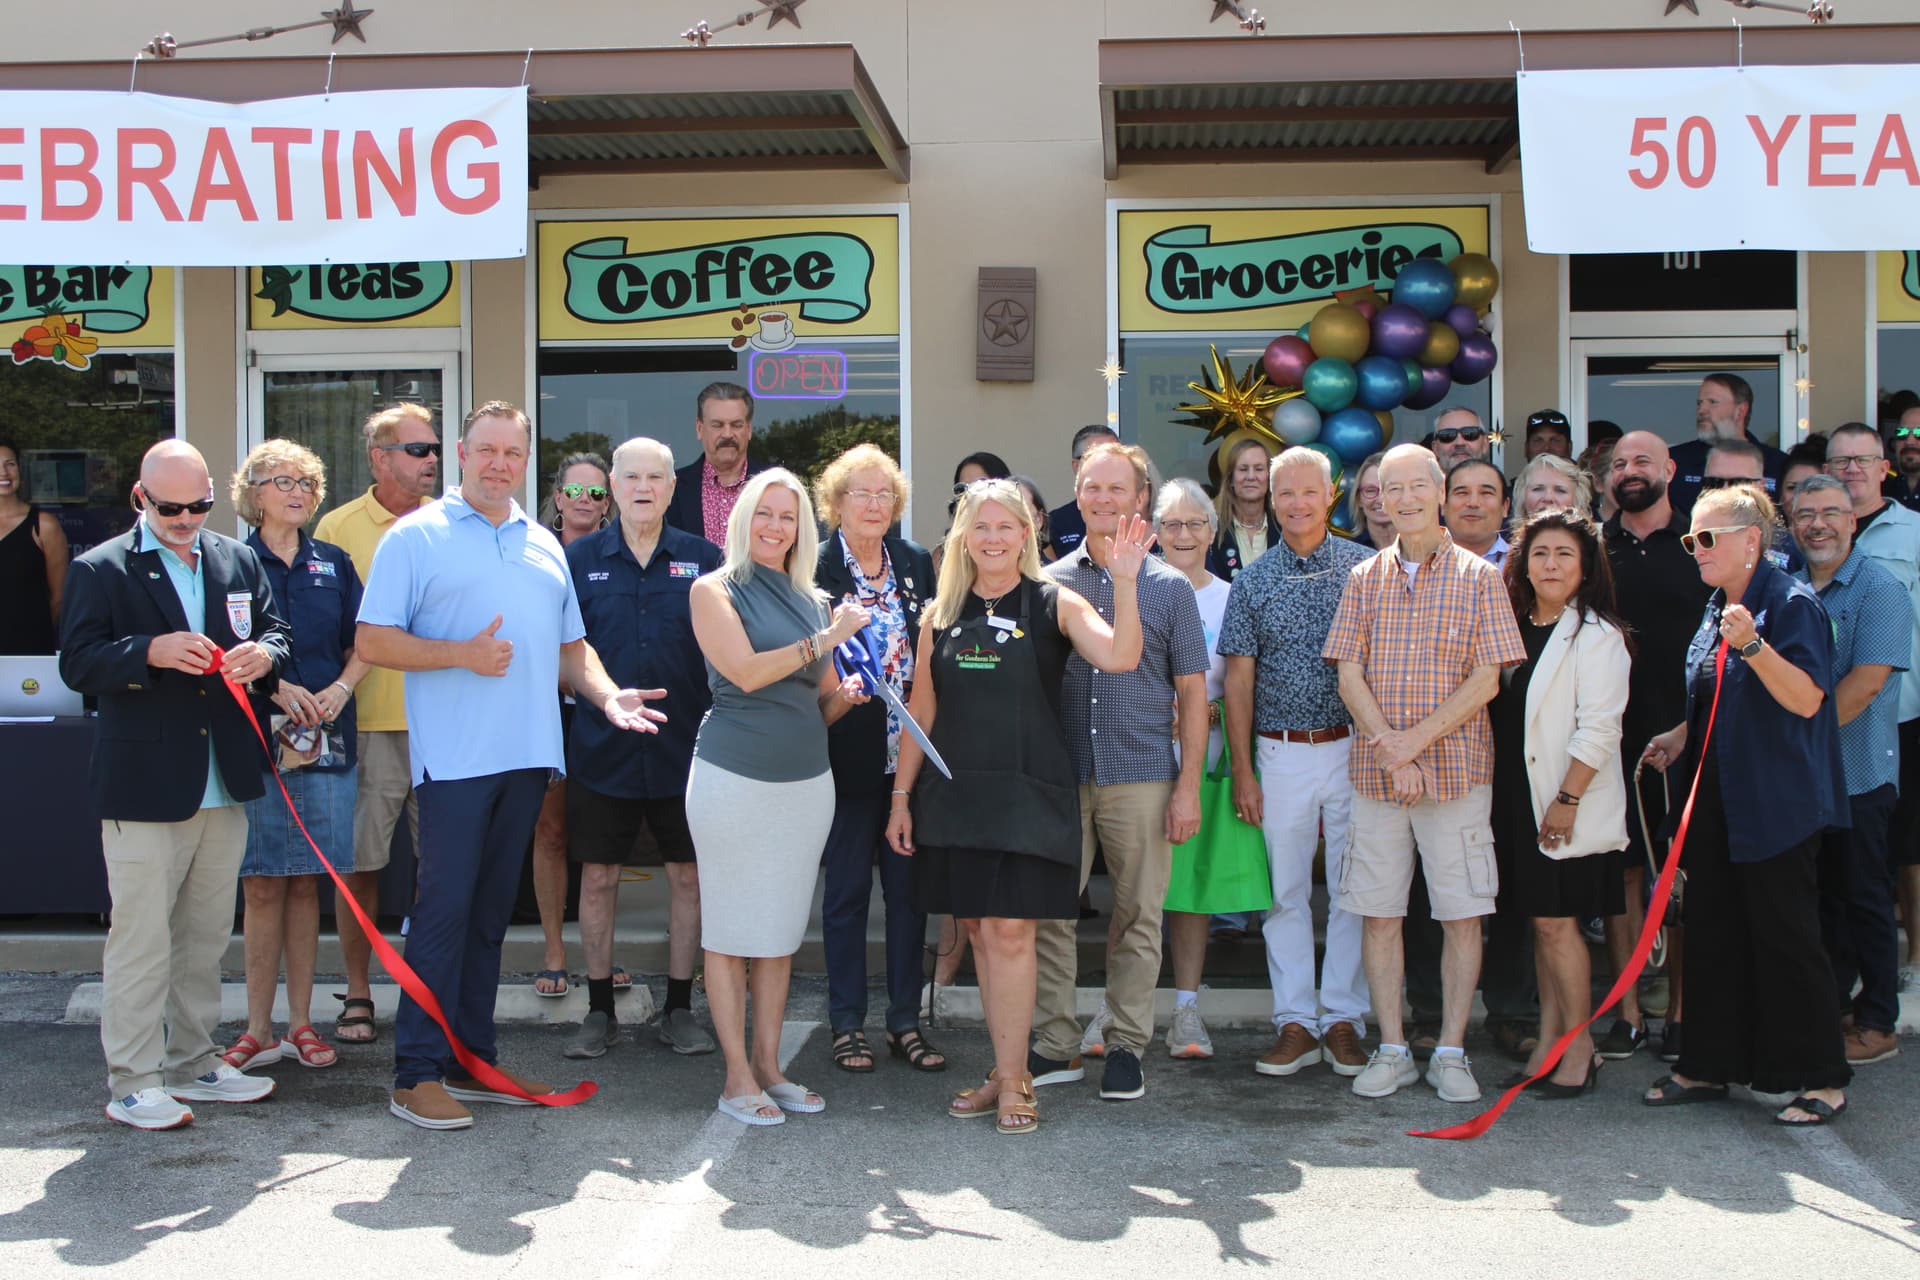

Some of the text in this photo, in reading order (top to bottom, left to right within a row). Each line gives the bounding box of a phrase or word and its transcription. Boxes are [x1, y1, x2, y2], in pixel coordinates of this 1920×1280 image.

[1627, 113, 1920, 190] 50 YEA
[23, 265, 133, 308] Bar
[597, 246, 836, 314] Coffee
[755, 357, 840, 391] OPEN
